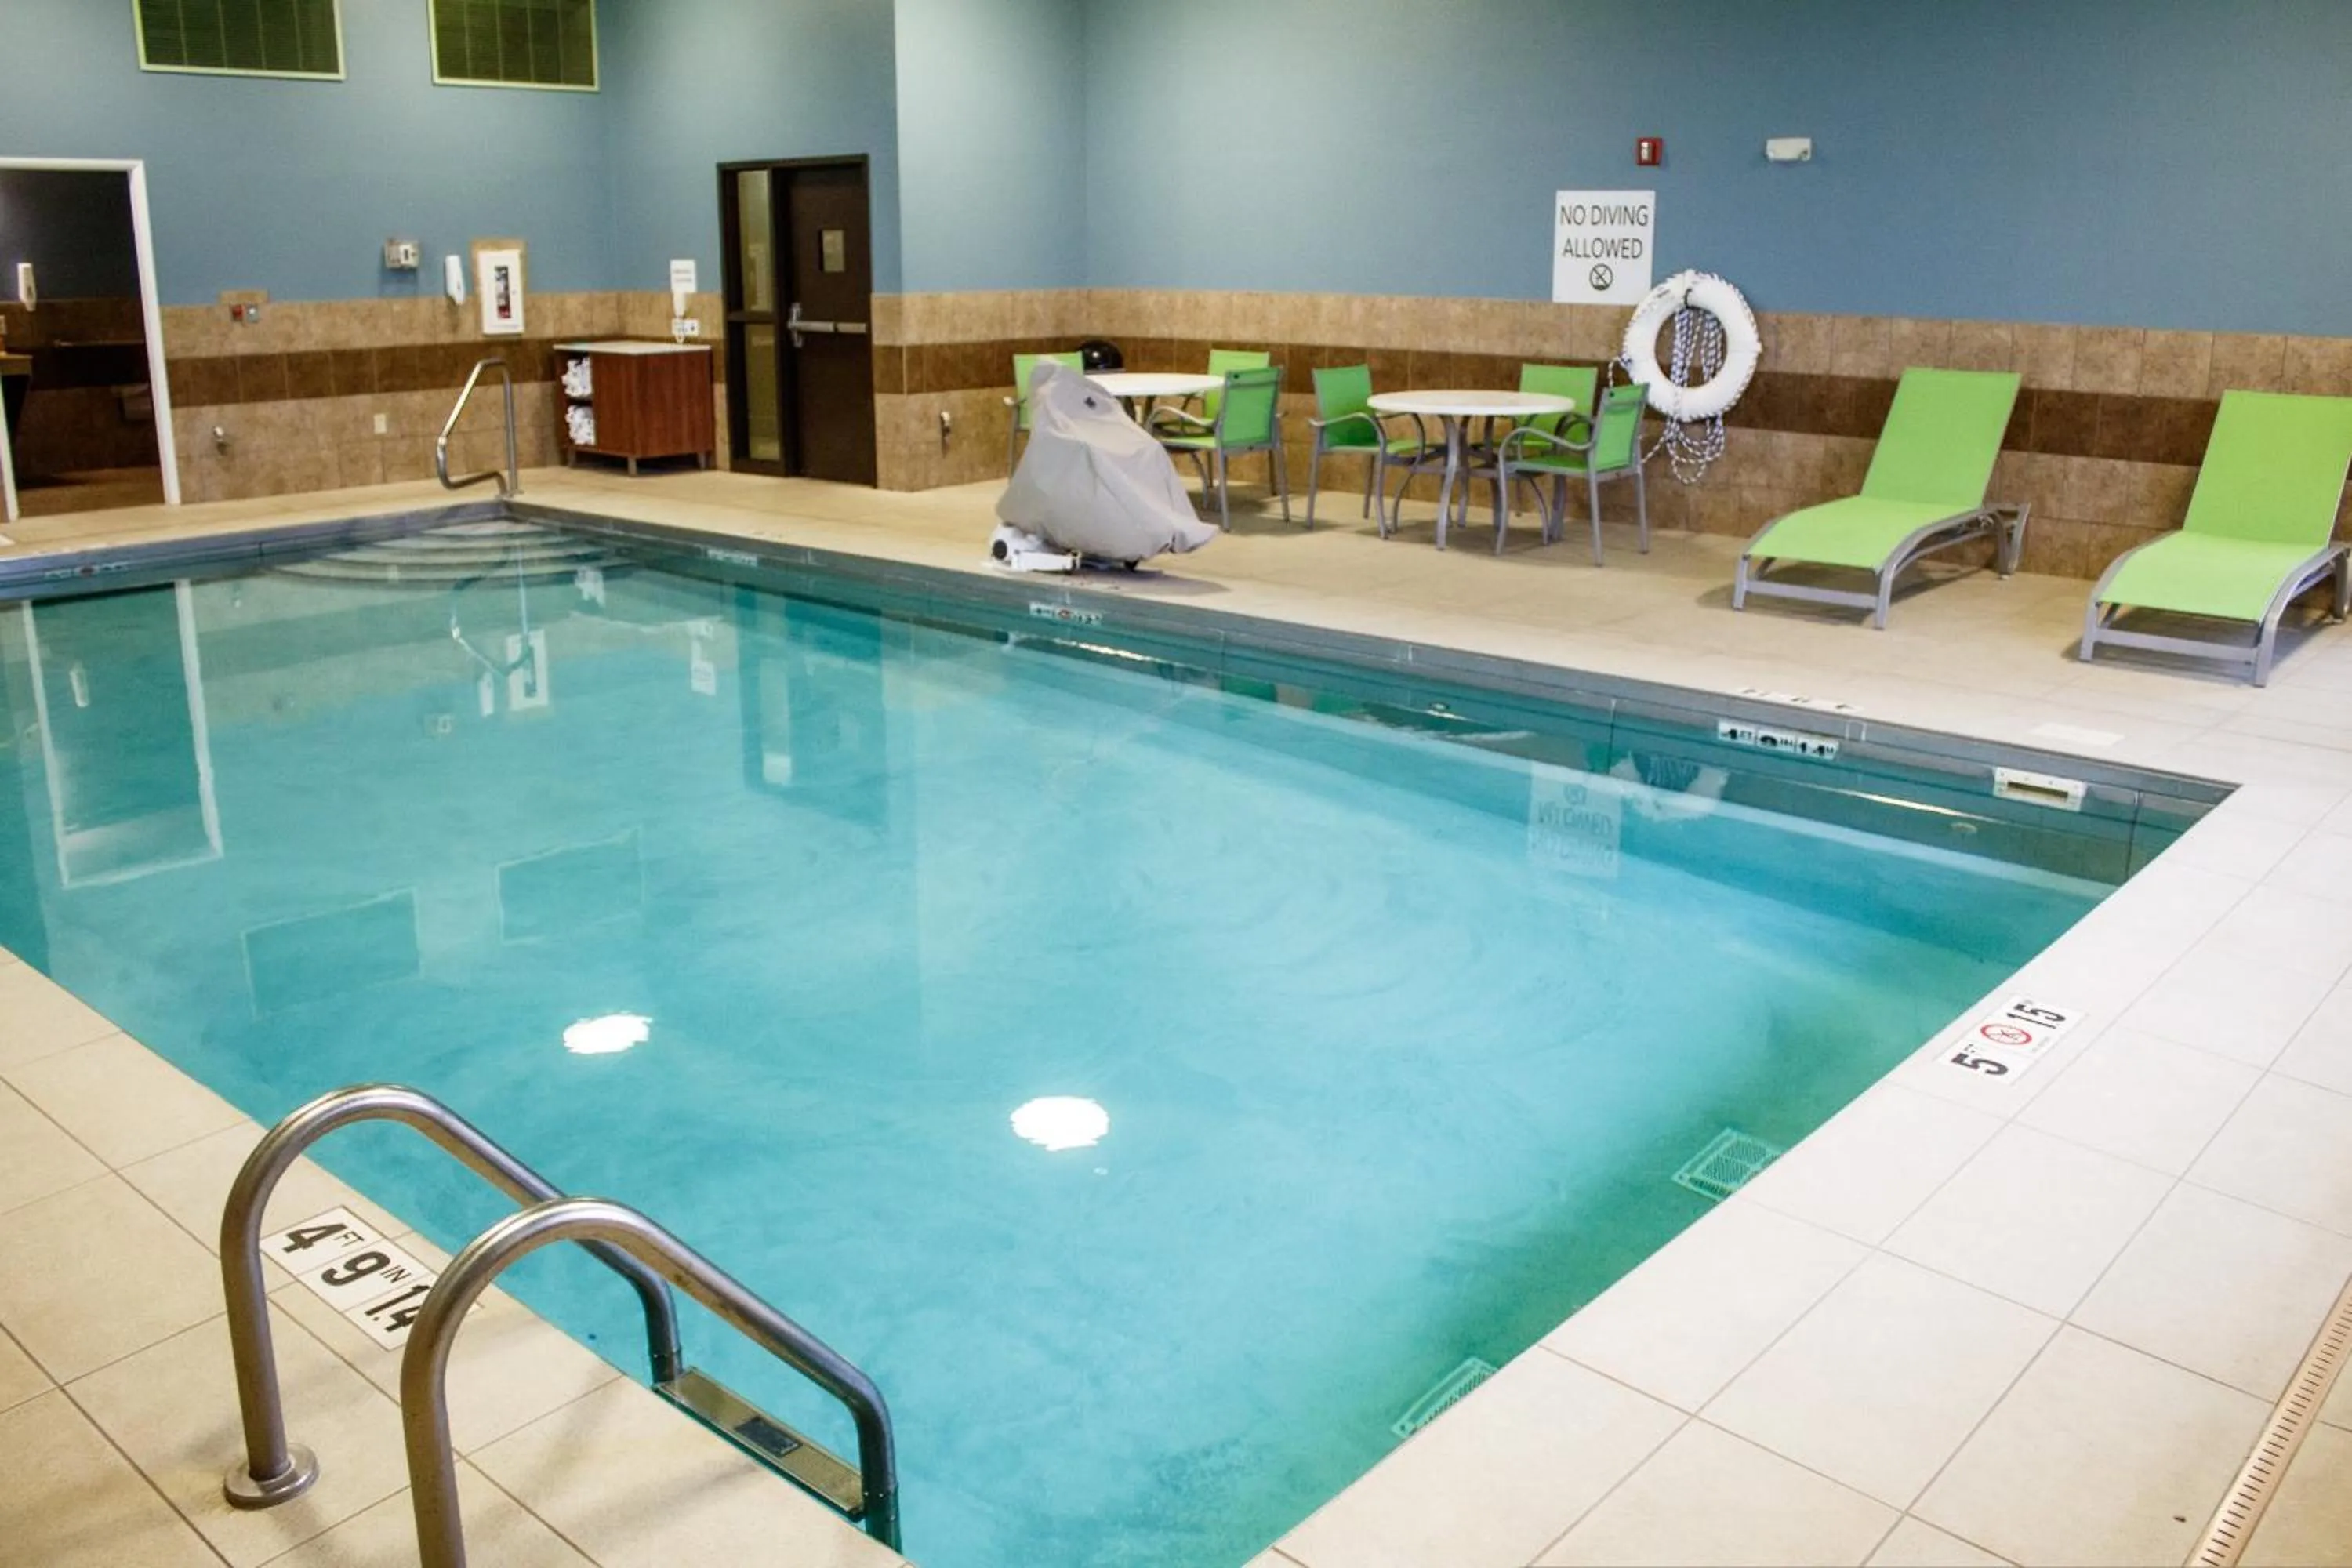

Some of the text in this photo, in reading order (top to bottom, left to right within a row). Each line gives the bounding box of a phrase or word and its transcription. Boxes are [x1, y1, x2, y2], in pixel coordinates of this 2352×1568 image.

[1559, 205, 1650, 227] NO DIVING
[1562, 237, 1643, 259] ALLOWED
[1951, 1052, 2009, 1075] 5
[281, 1223, 348, 1254] 4
[333, 1230, 366, 1249] FT
[320, 1250, 392, 1287] 9
[379, 1264, 412, 1283] IN
